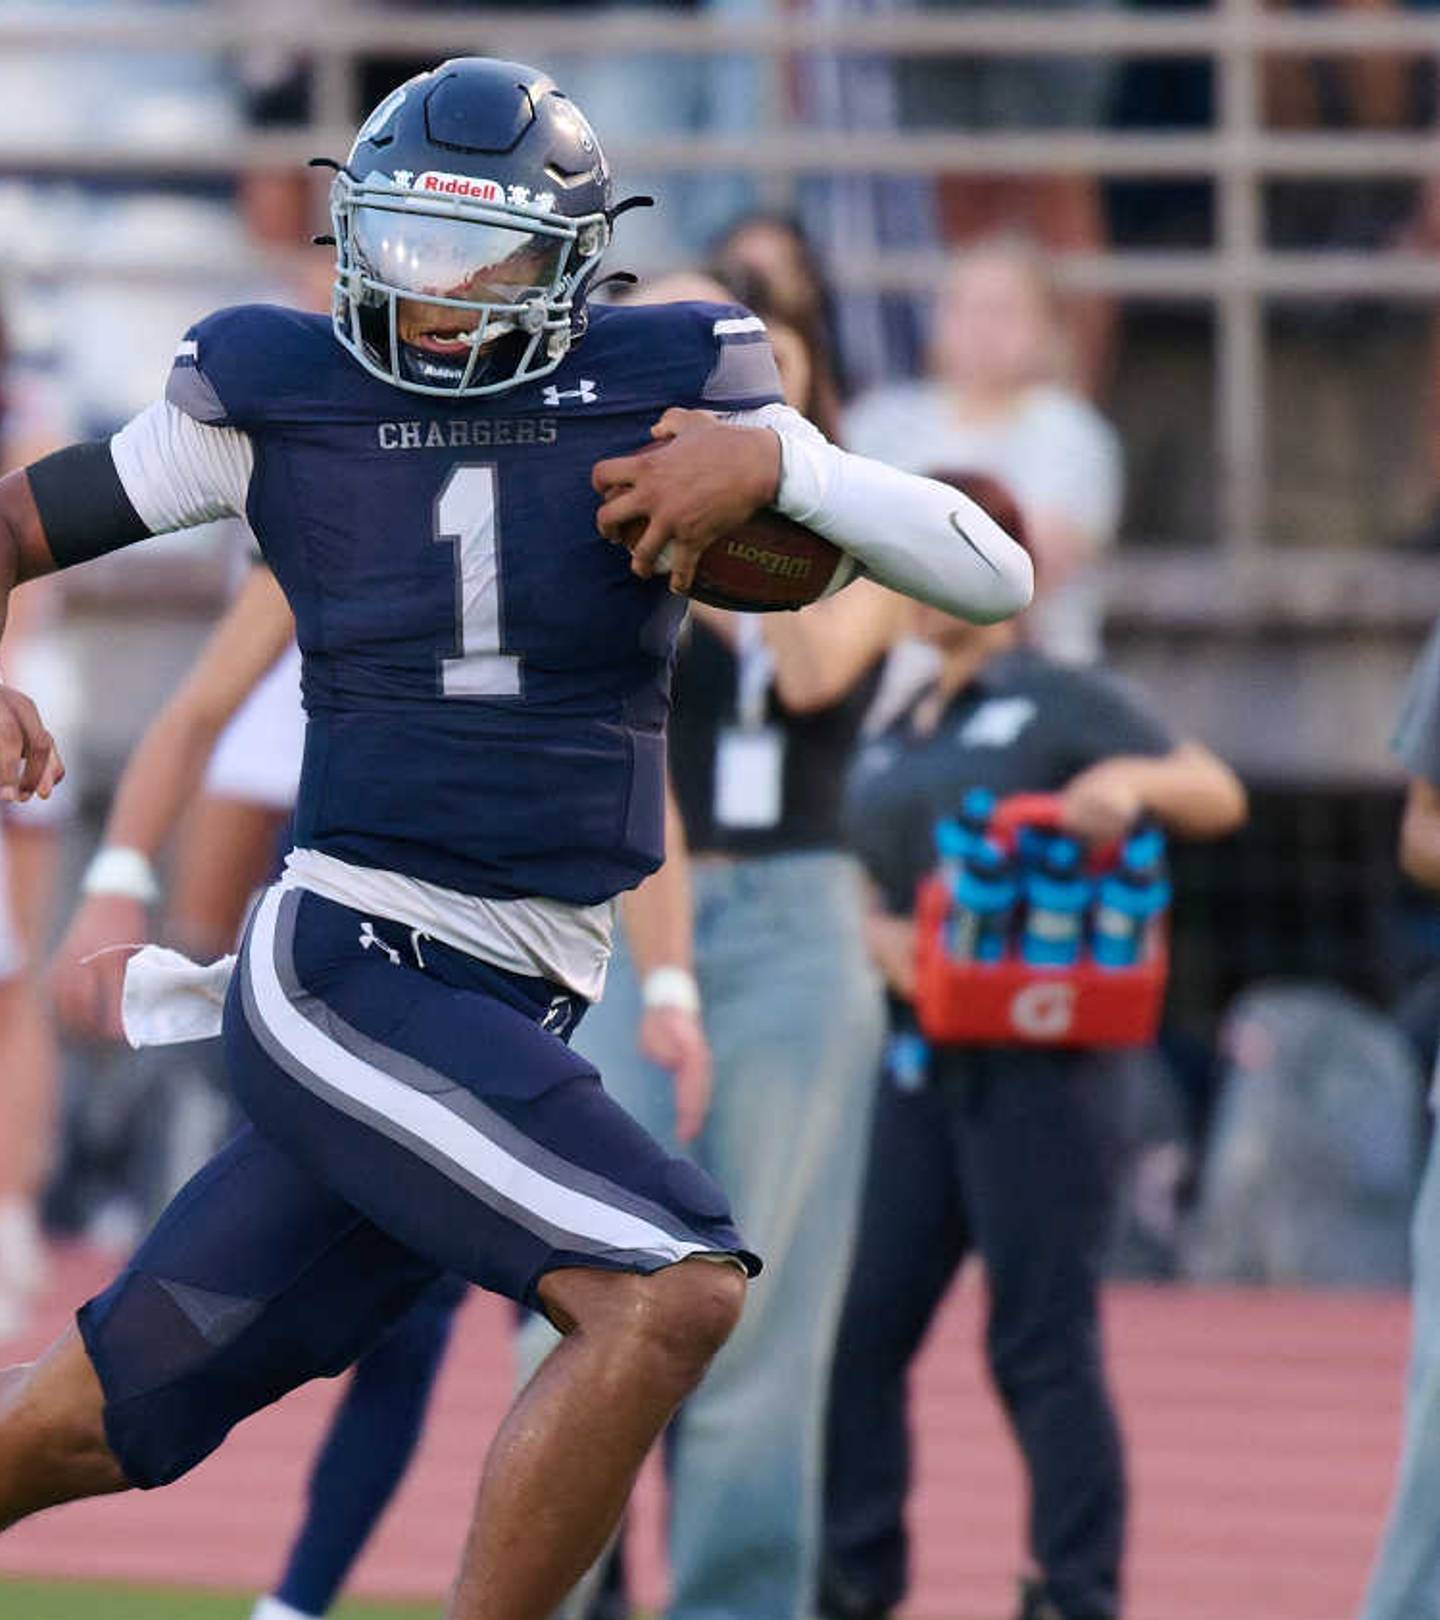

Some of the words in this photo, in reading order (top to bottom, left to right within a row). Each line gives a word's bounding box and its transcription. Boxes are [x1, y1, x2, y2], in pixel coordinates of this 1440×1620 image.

[423, 176, 497, 201] Riddell
[378, 419, 557, 449] CHARGERS
[434, 462, 523, 698] 1
